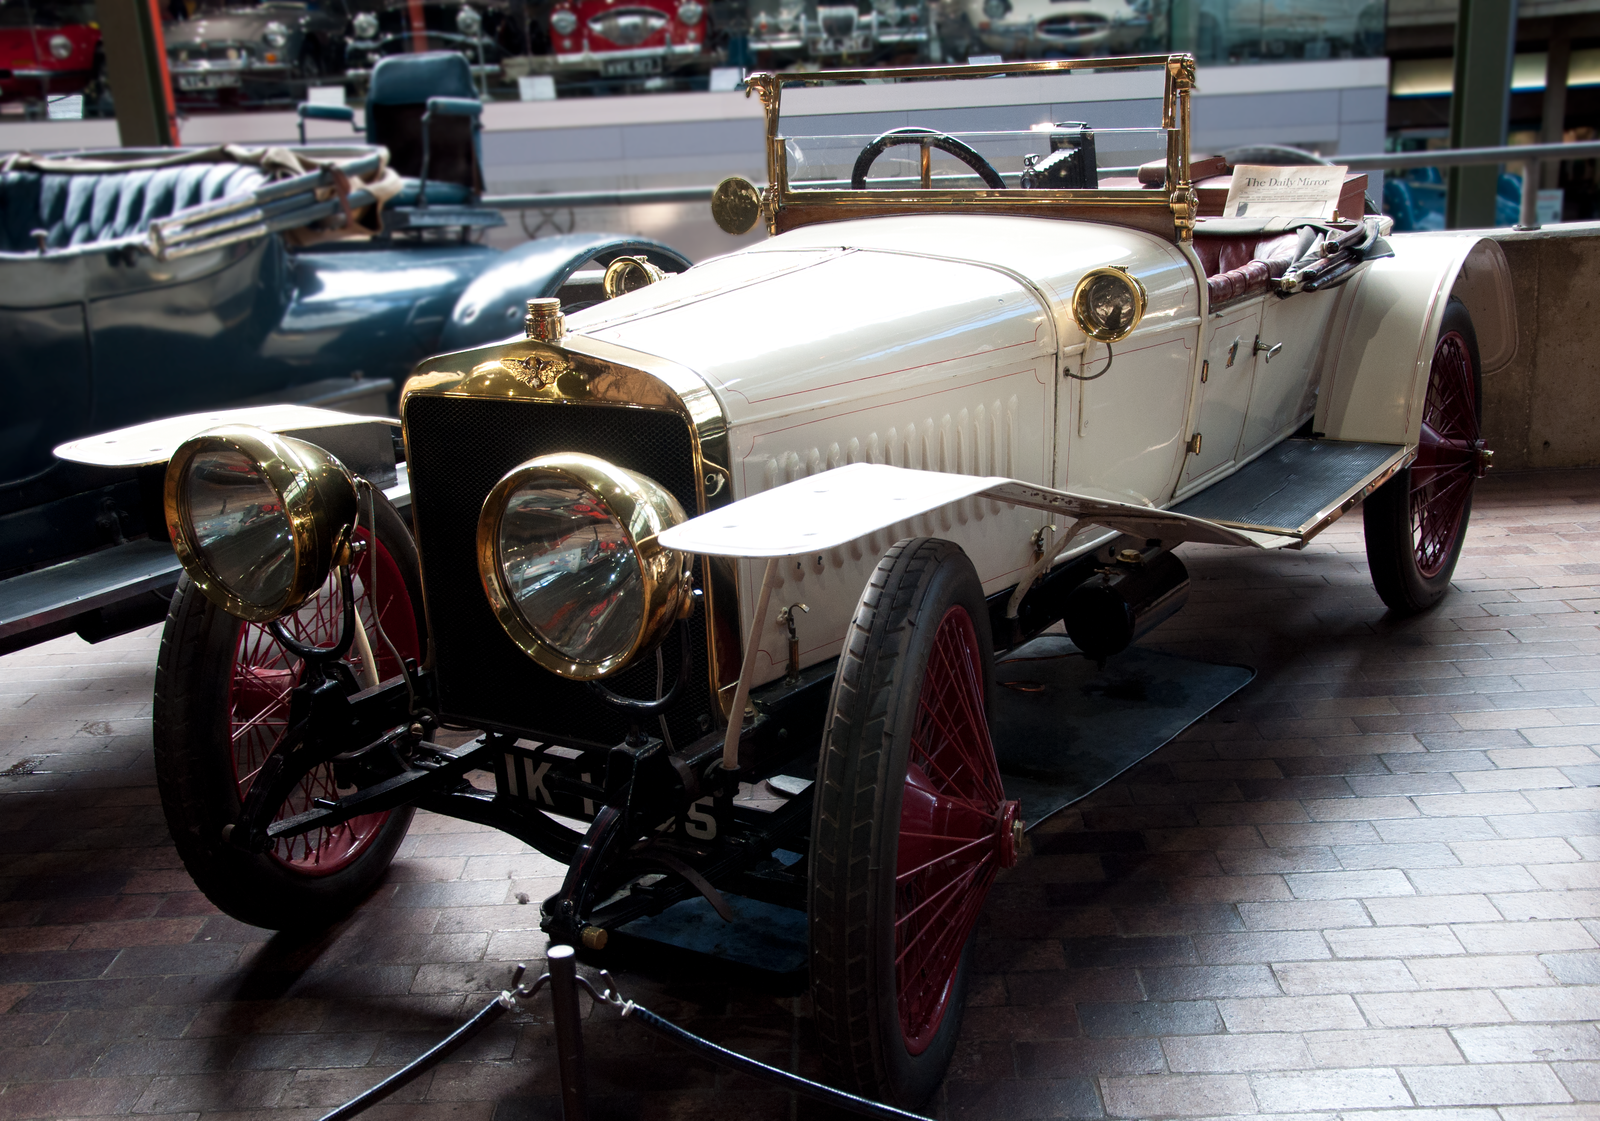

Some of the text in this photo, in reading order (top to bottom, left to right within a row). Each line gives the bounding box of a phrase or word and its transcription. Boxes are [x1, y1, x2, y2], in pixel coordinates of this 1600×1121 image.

[1245, 177, 1330, 188] The Daily Mirror
[504, 752, 555, 807] IK
